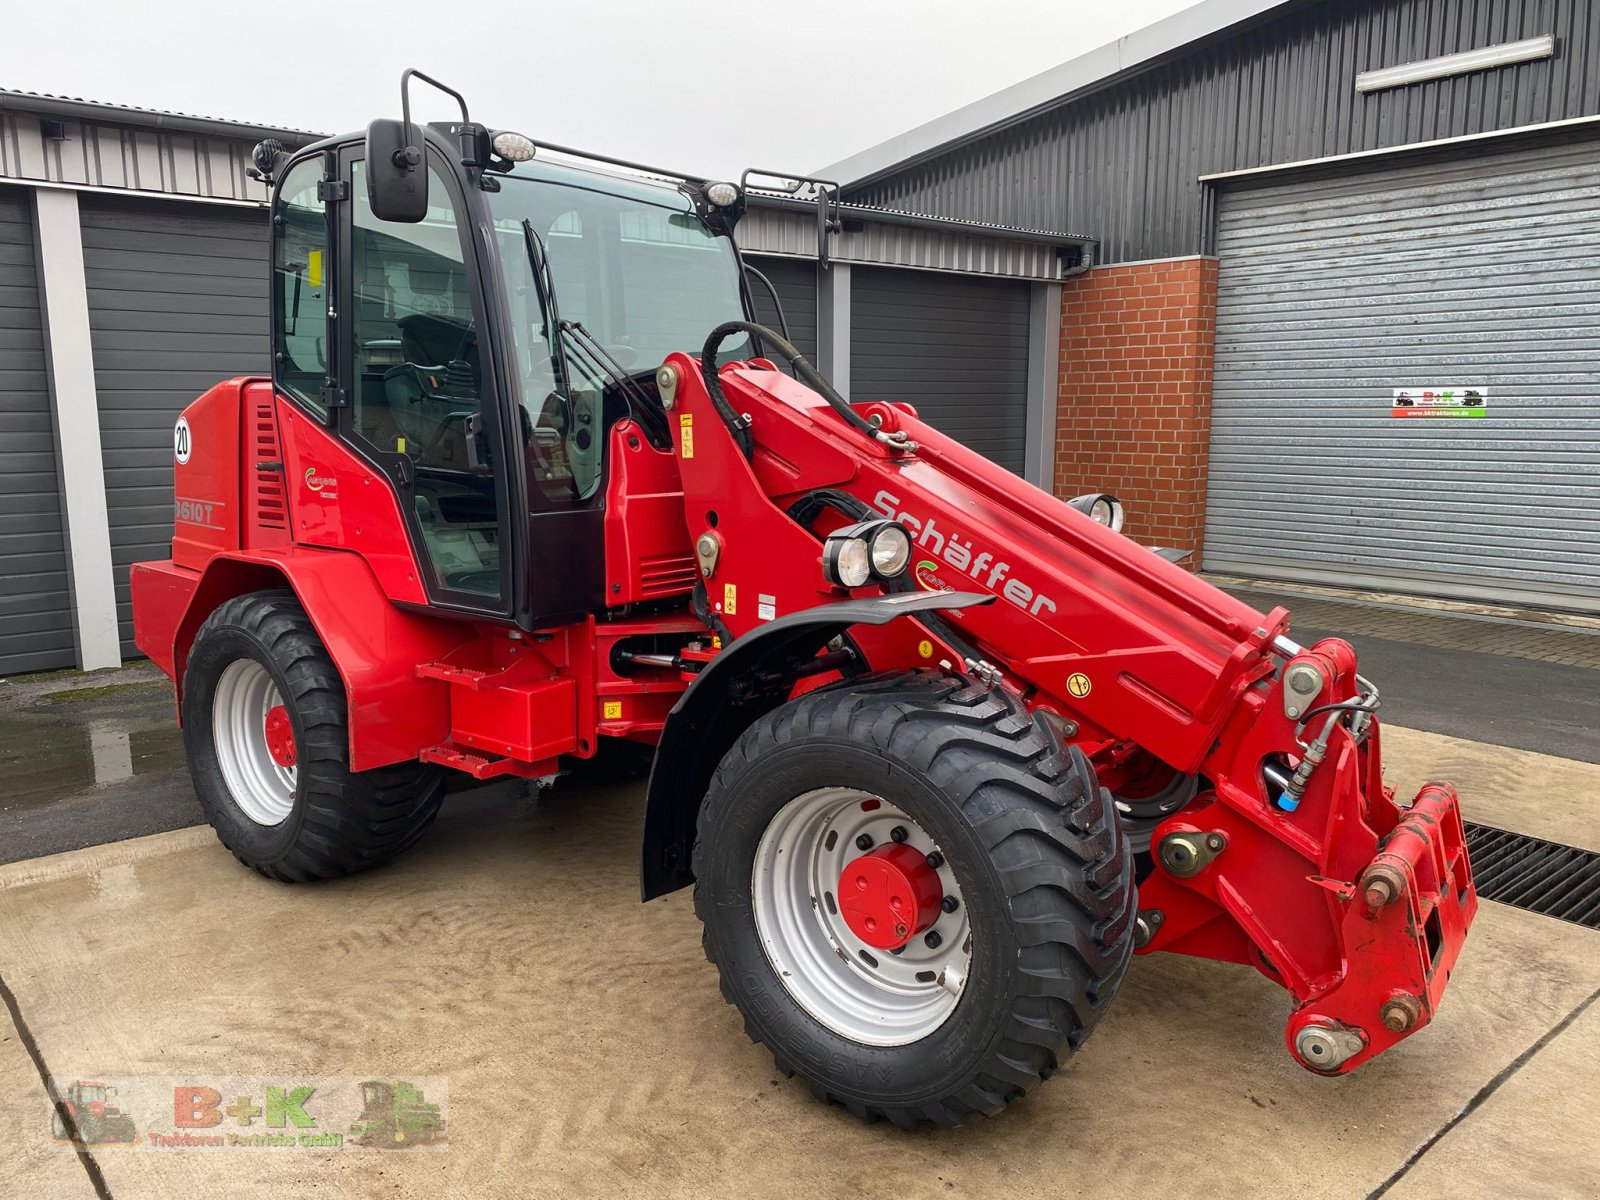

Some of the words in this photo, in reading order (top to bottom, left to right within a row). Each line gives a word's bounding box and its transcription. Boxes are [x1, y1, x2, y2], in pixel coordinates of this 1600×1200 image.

[1423, 391, 1454, 401] B+K
[176, 426, 188, 455] 20
[873, 490, 1057, 616] Schäffer
